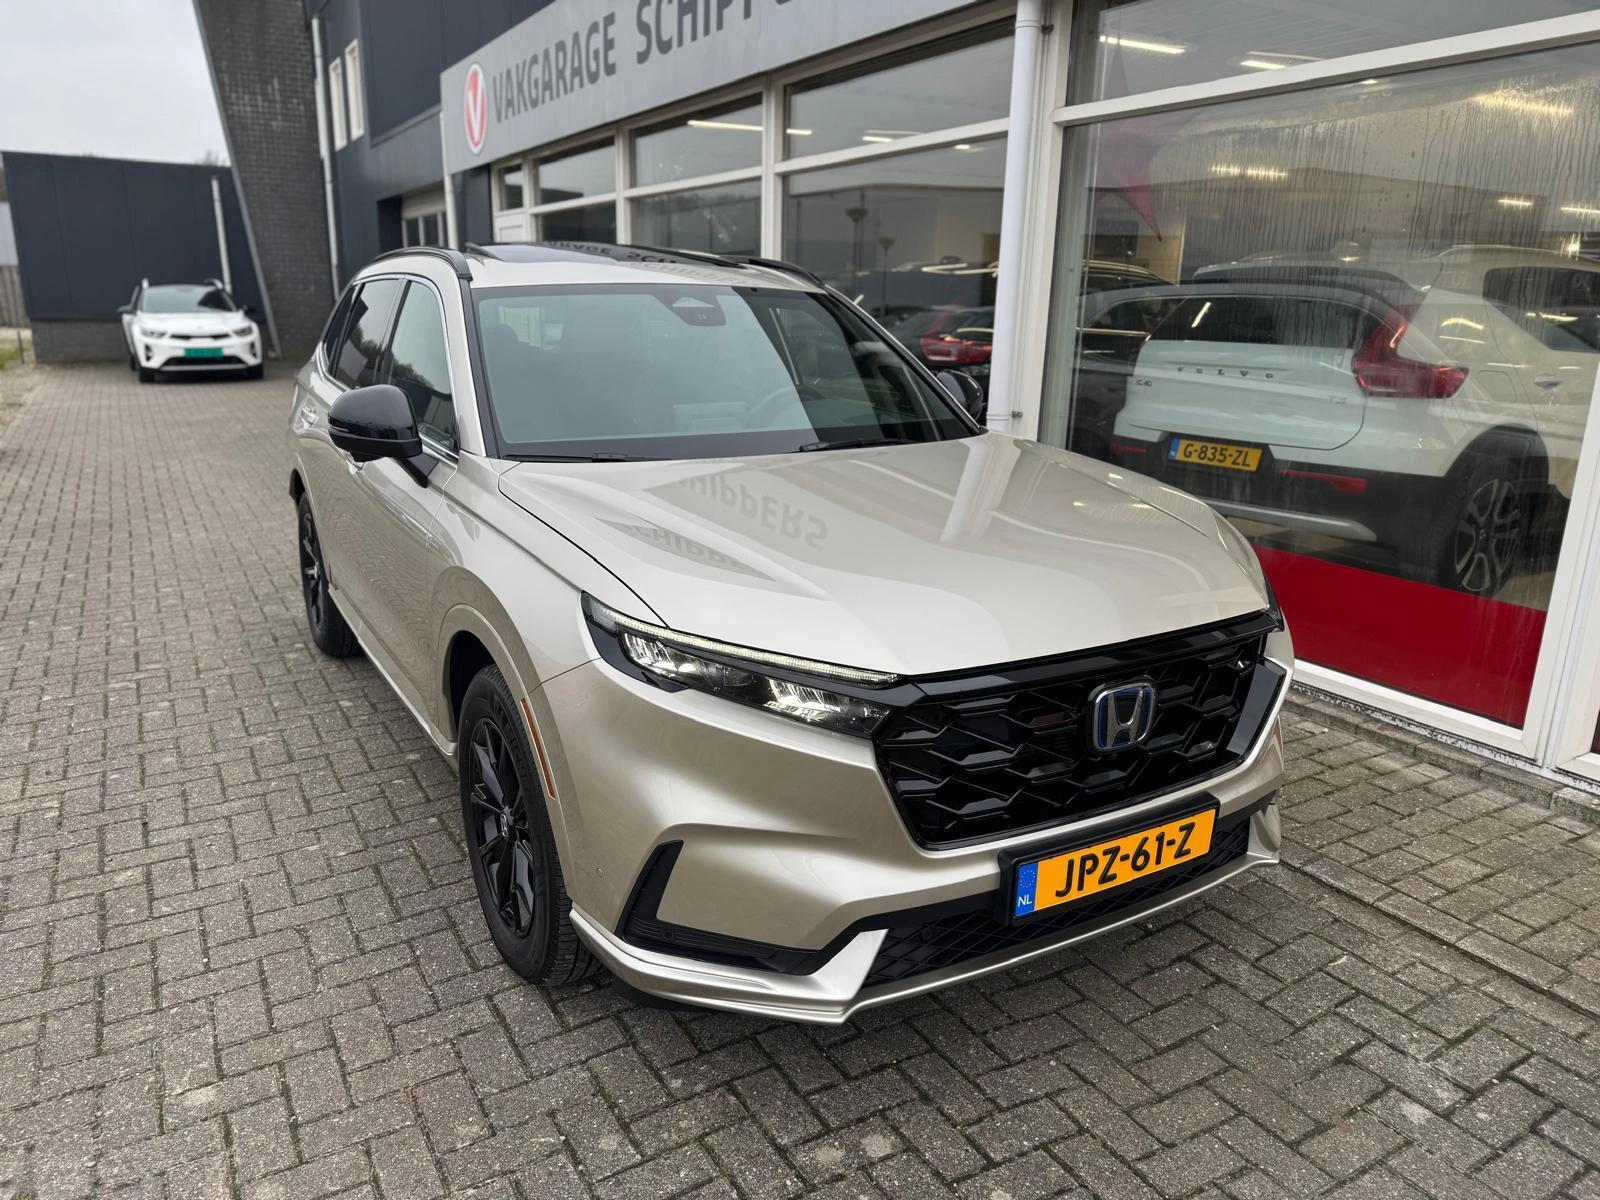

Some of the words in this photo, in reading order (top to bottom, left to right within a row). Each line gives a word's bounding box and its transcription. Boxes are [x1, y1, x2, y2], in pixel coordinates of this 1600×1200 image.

[493, 12, 617, 123] VAKGARAGE
[1183, 443, 1251, 467] G-835-ZL
[1055, 821, 1196, 898] JPZ-61-Z
[1017, 894, 1033, 907] NL
